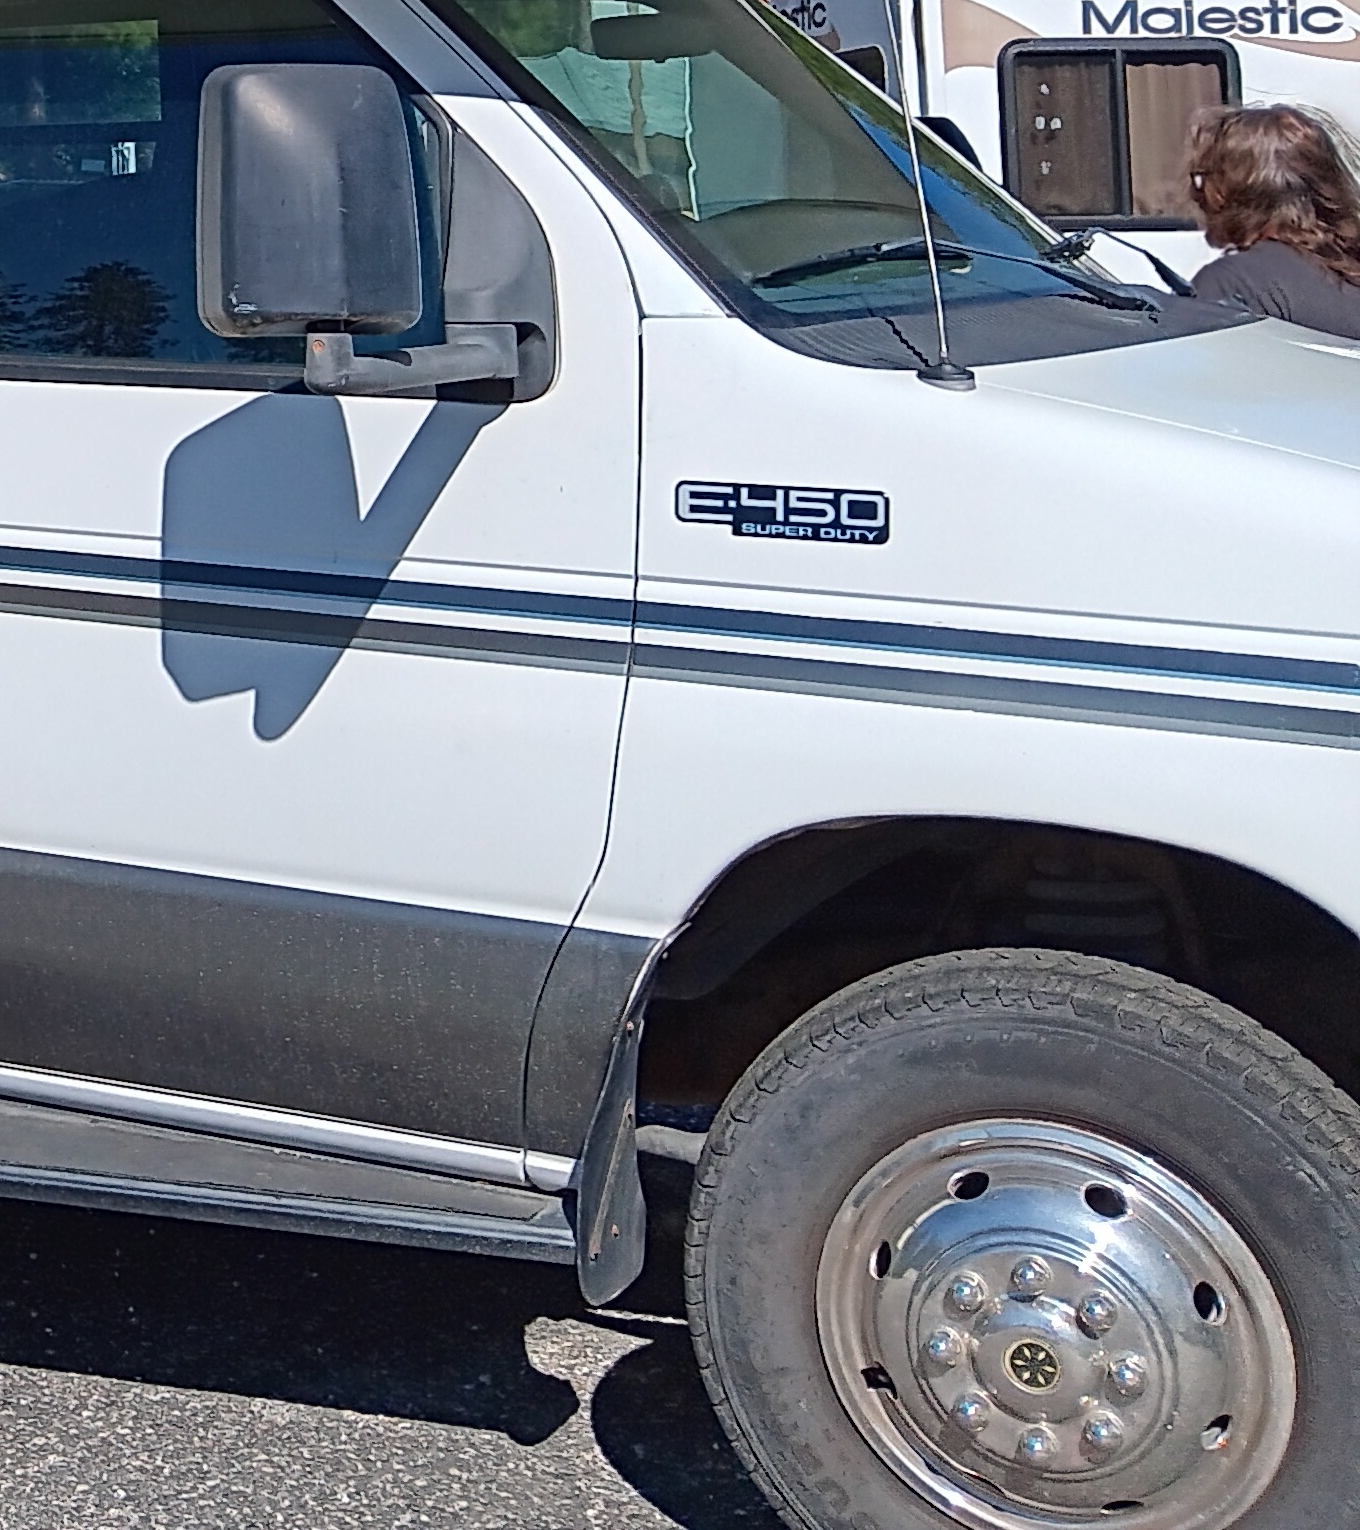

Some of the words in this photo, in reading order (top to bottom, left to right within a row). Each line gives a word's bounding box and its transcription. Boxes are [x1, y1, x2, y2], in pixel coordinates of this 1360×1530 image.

[1081, 0, 1344, 39] Majestic
[741, 523, 813, 537] SUPER
[820, 527, 880, 541] DUTY
